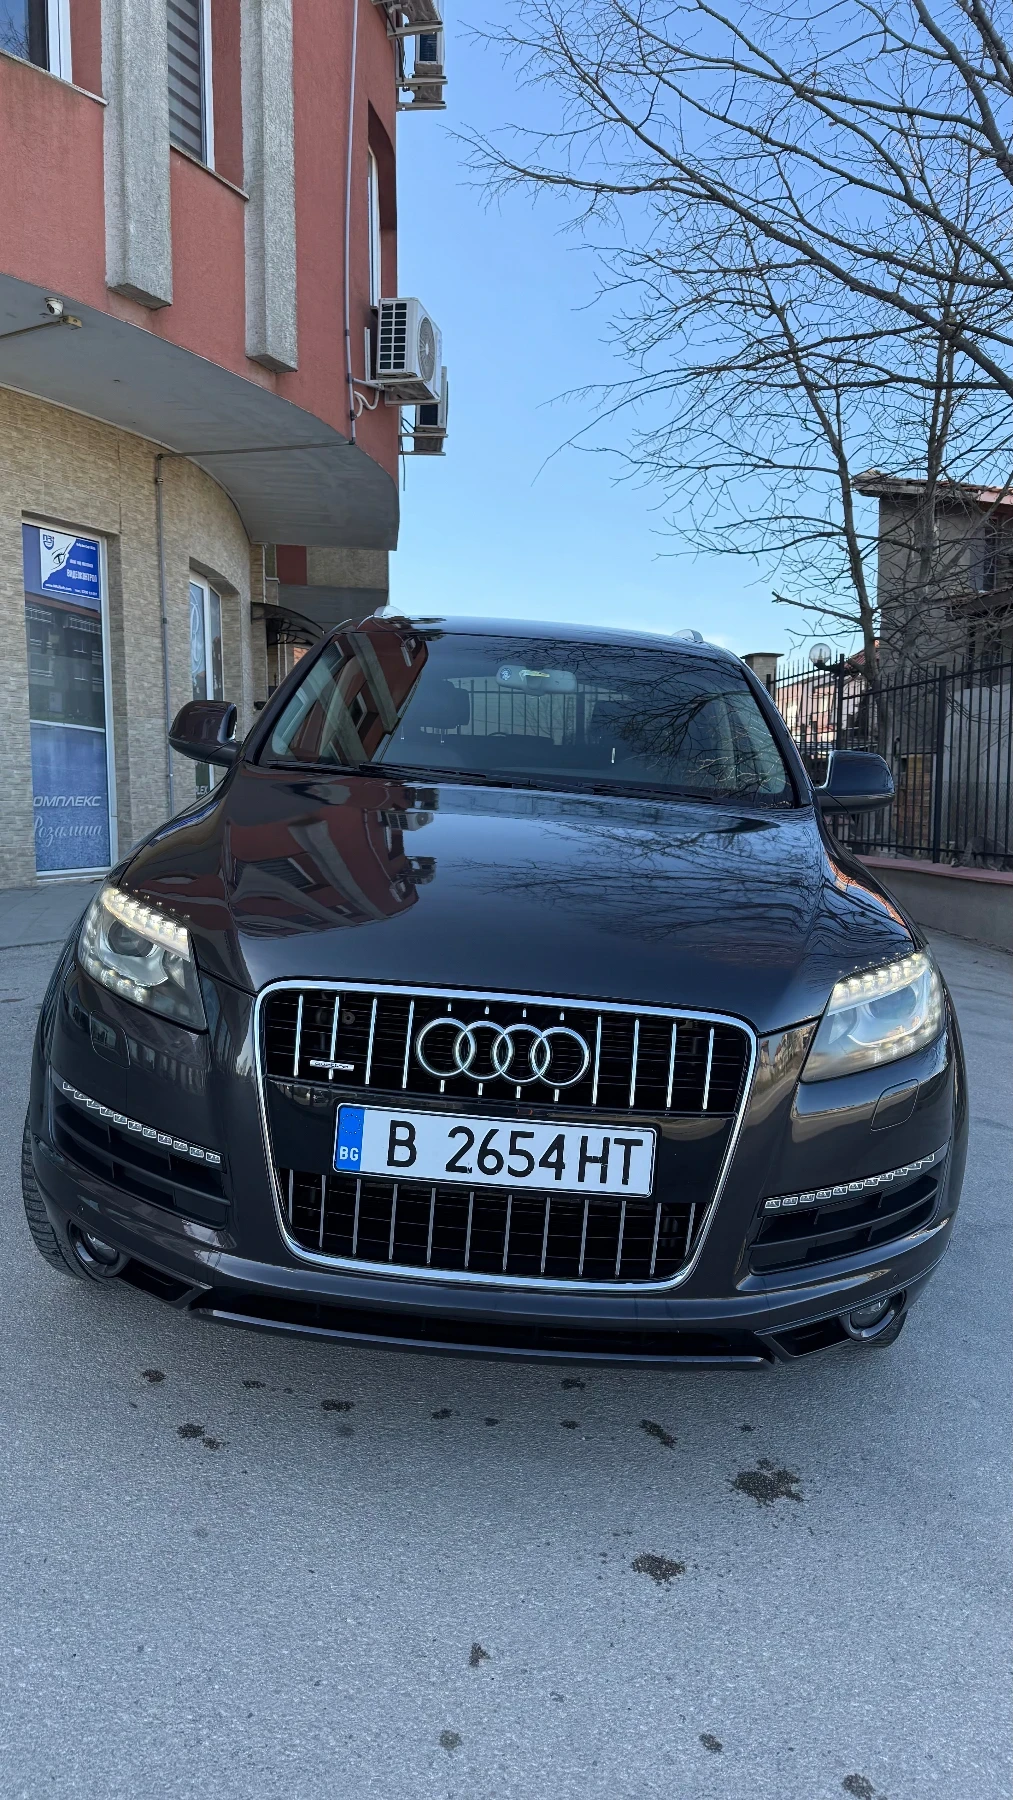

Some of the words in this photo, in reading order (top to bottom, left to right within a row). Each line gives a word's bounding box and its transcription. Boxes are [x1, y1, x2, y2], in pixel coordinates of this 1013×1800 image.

[33, 795, 102, 807] ОМПЛЕКС
[387, 1119, 417, 1168] B
[339, 1146, 359, 1162] BG
